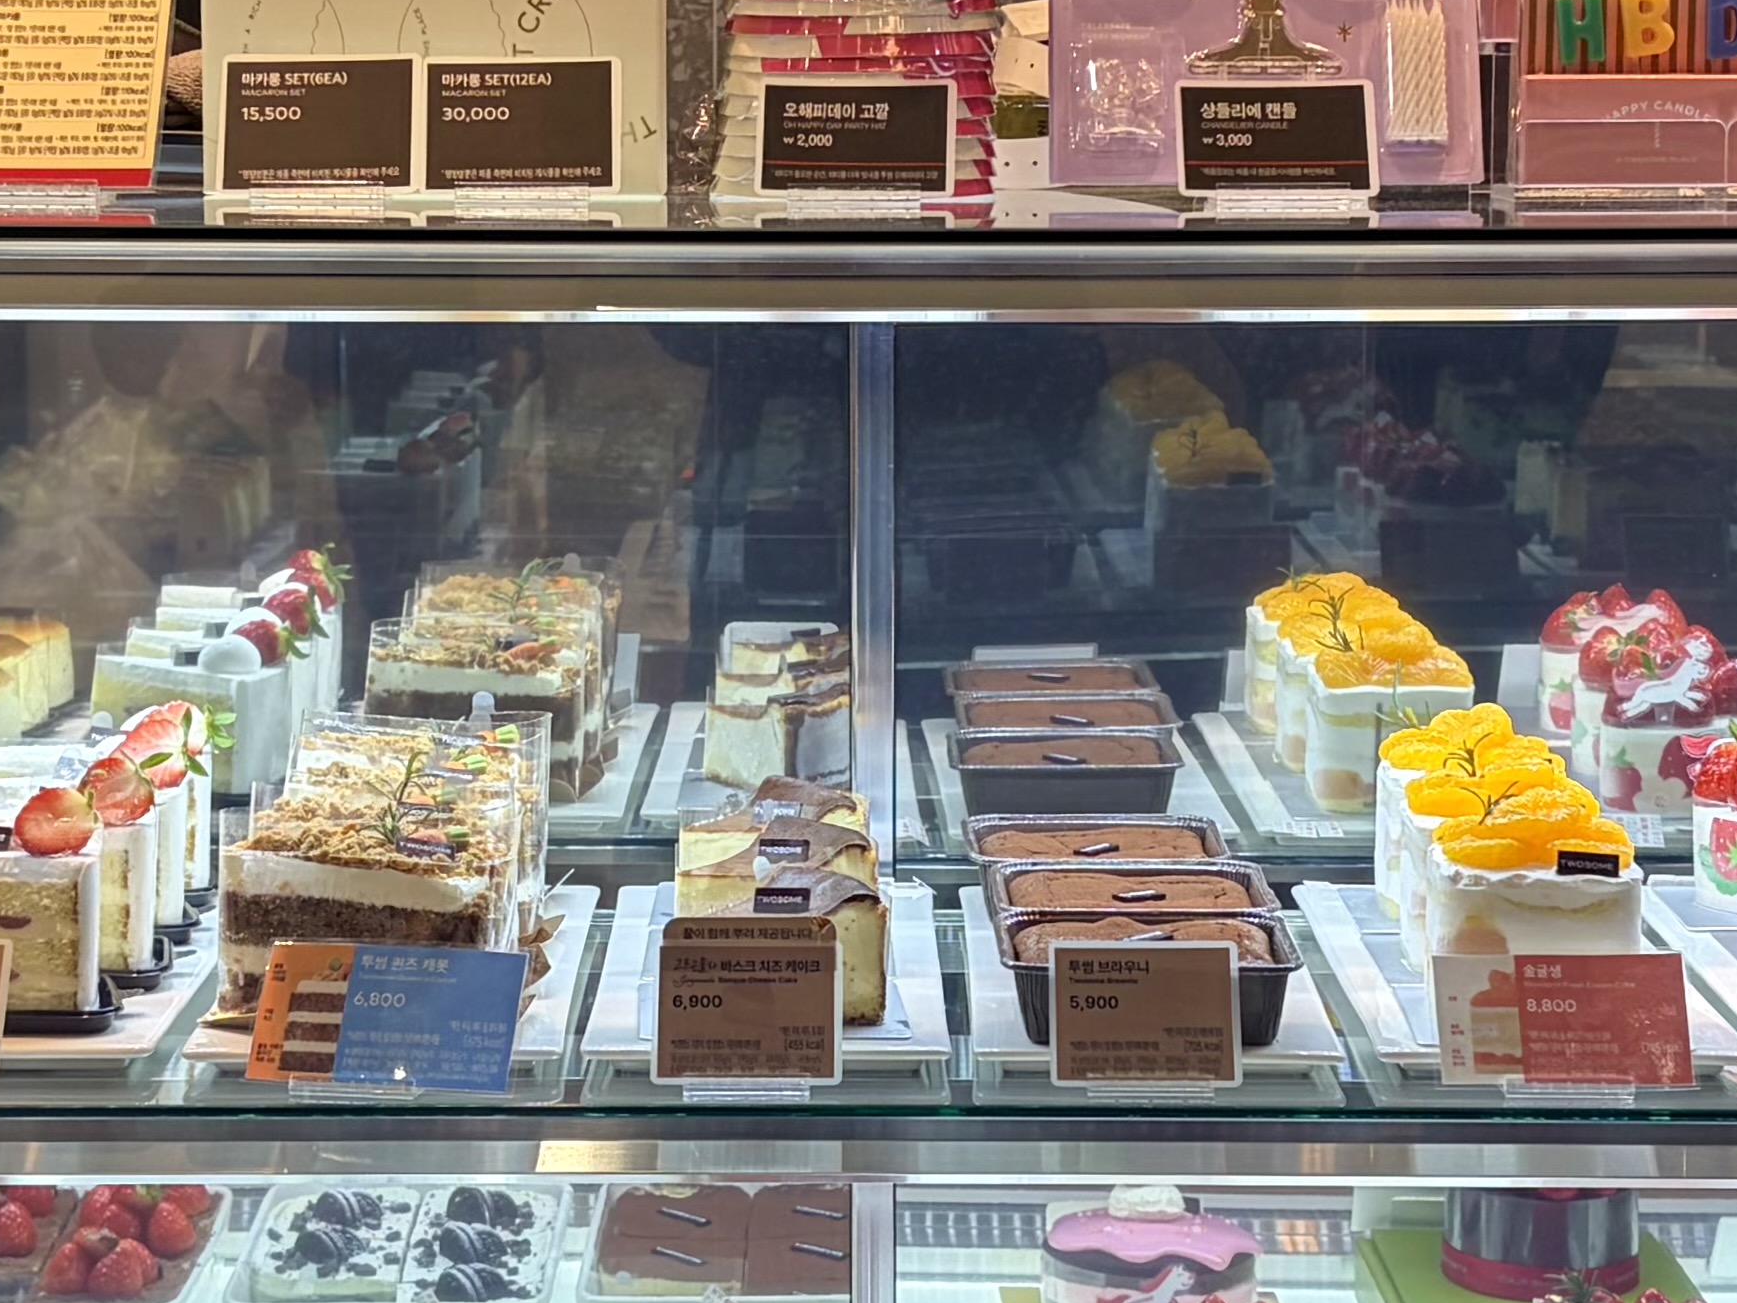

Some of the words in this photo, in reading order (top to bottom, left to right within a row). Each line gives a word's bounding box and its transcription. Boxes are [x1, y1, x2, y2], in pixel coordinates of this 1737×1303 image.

[241, 72, 281, 86] 마카롱
[284, 72, 348, 87] SET(6EA)
[441, 72, 482, 87] 마카롱
[485, 72, 552, 87] SET(12EA)
[241, 106, 301, 123] 15,500
[441, 106, 510, 123] 30,000
[783, 102, 856, 120] 오해피데이
[859, 102, 890, 120] 고깔
[1200, 102, 1262, 120] 샹들리에
[1265, 102, 1297, 120] 캔들
[1201, 121, 1254, 130] CHANDELIER
[1256, 122, 1288, 130] CANDLE
[796, 134, 833, 148] 2,000
[1216, 134, 1253, 148] 3,000
[720, 959, 757, 973] 바스크
[758, 959, 783, 973] 치즈
[785, 959, 821, 974] 케이크
[1068, 960, 1094, 975] 투썸
[1098, 959, 1150, 975] 브라우니
[353, 991, 406, 1008] 6,800
[672, 994, 723, 1011] 6,900
[1069, 995, 1119, 1012] 5,900
[1526, 998, 1577, 1013] 8,800
